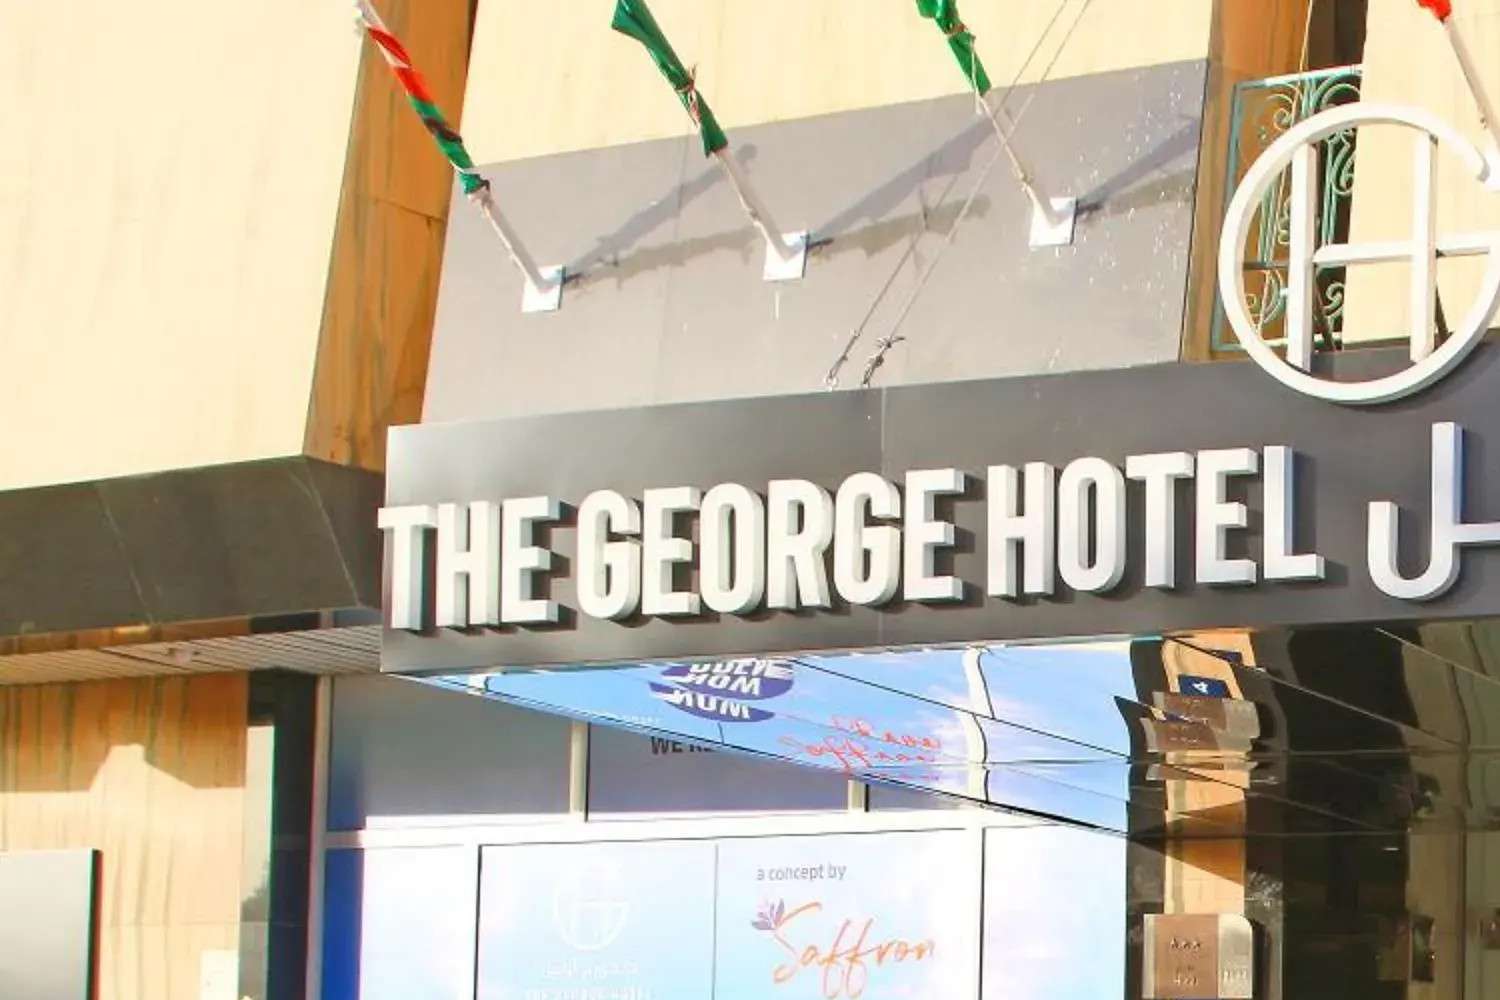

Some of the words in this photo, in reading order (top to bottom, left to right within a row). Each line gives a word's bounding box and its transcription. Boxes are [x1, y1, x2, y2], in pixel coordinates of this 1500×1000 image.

[377, 495, 561, 632] THE
[577, 467, 967, 621] GEORGE
[985, 444, 1326, 599] HOTEL
[756, 868, 765, 881] a
[768, 864, 825, 881] concept
[827, 863, 847, 880] by
[771, 901, 935, 1000] Saffron
